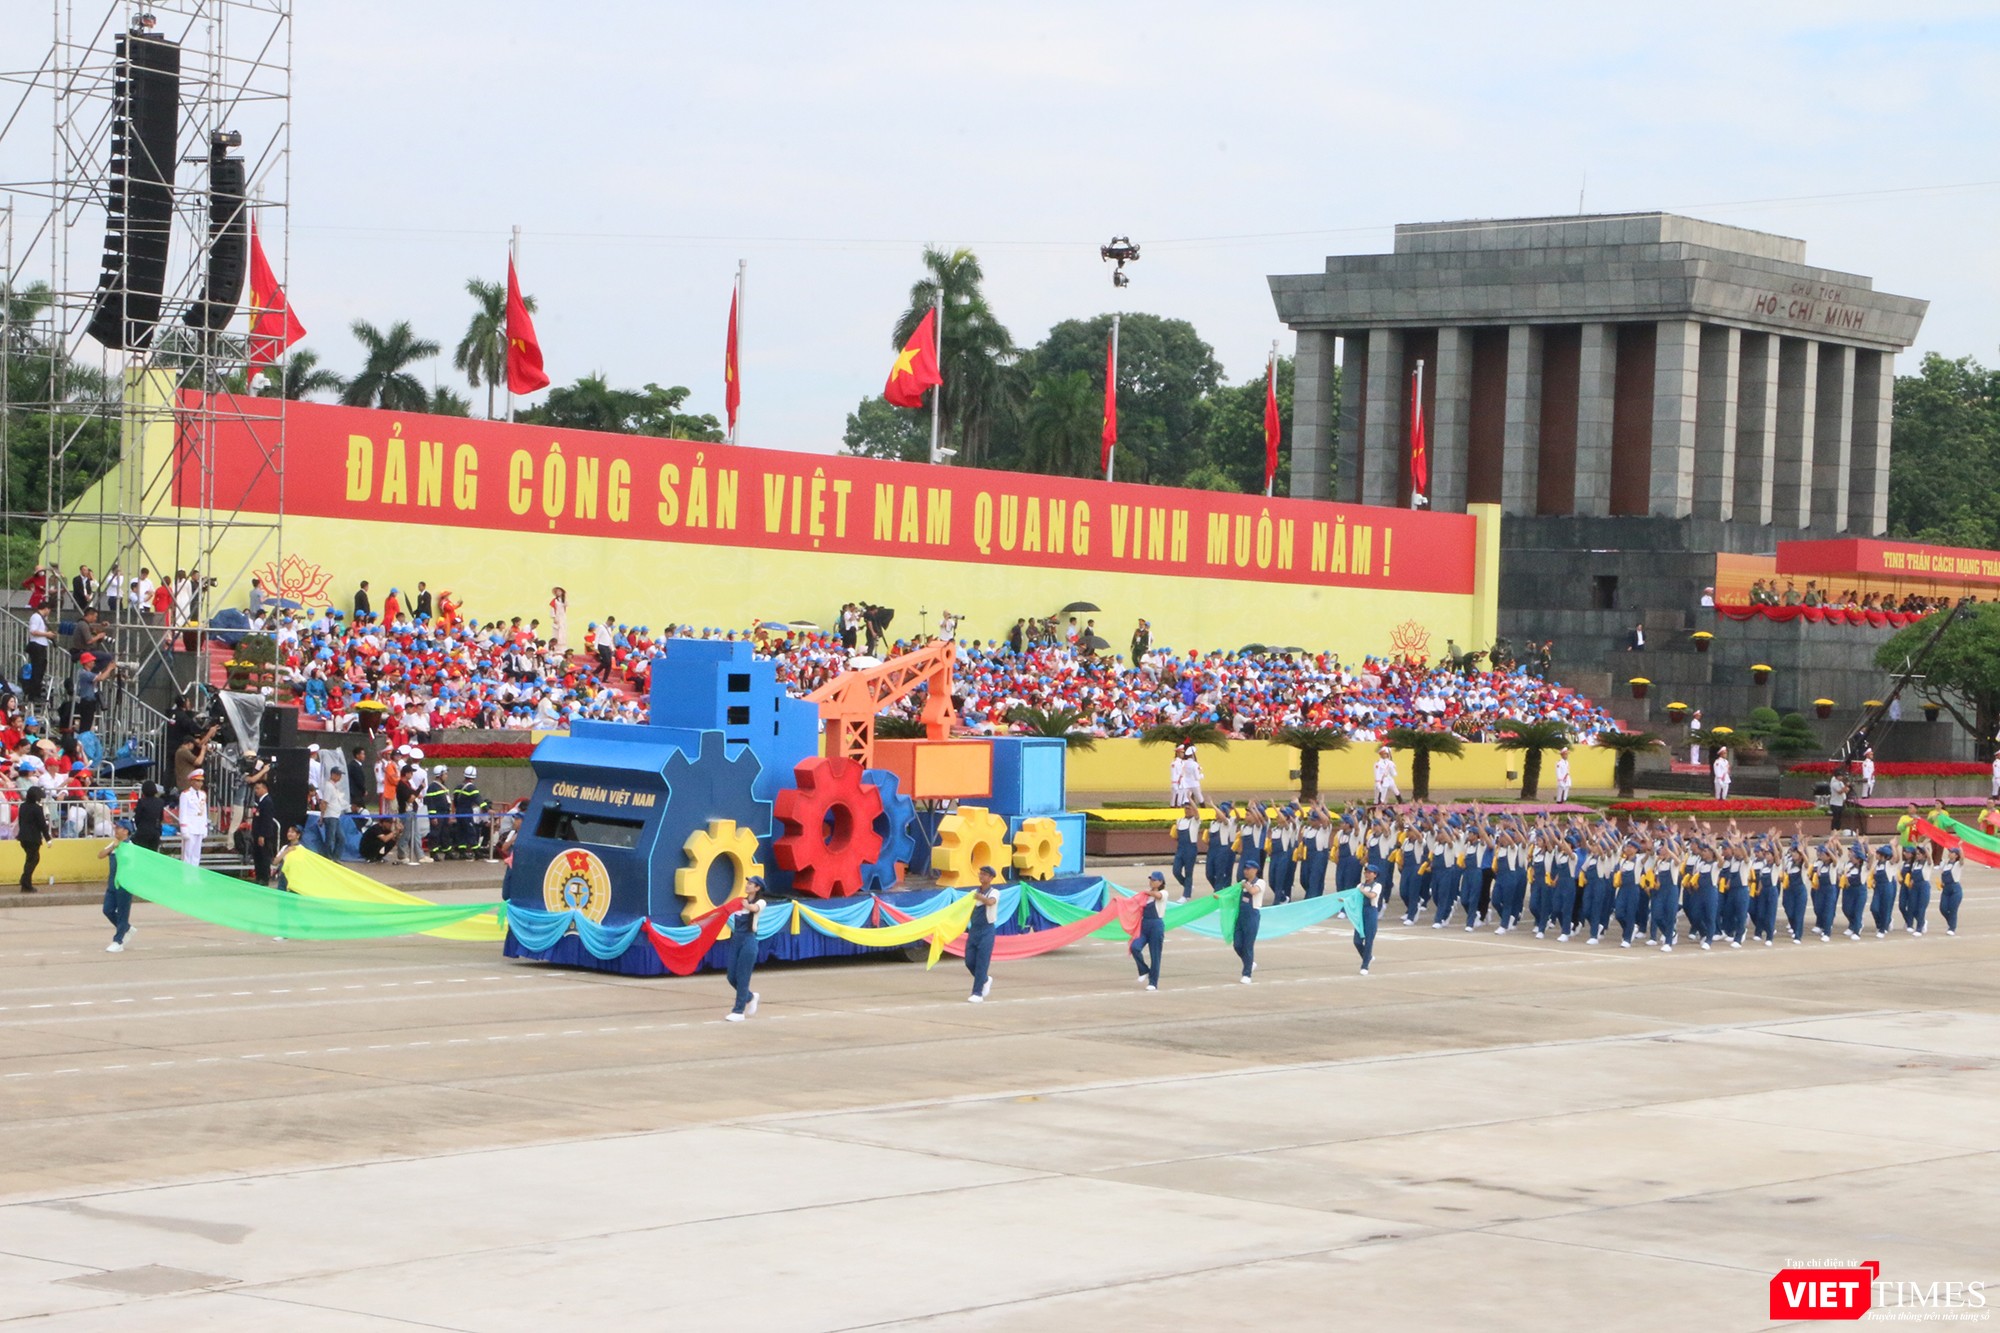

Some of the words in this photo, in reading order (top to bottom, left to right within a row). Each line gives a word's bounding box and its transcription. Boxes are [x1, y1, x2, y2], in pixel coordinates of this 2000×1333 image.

[345, 421, 479, 510] ĐẢNG
[508, 442, 631, 529] CỘNG
[658, 452, 738, 530] SẢN
[763, 467, 851, 548] VIỆT
[874, 483, 951, 546] NAM
[974, 491, 1091, 556] QUANG
[1111, 504, 1189, 563] VINH
[1207, 508, 1295, 570] MUÔN
[1883, 551, 1905, 569] TINH
[1981, 557, 2000, 577] THÁ
[552, 781, 579, 799] CÔNG
[579, 786, 608, 803] NHÂN
[608, 788, 631, 807] VIỆT
[632, 792, 657, 807] NAM
